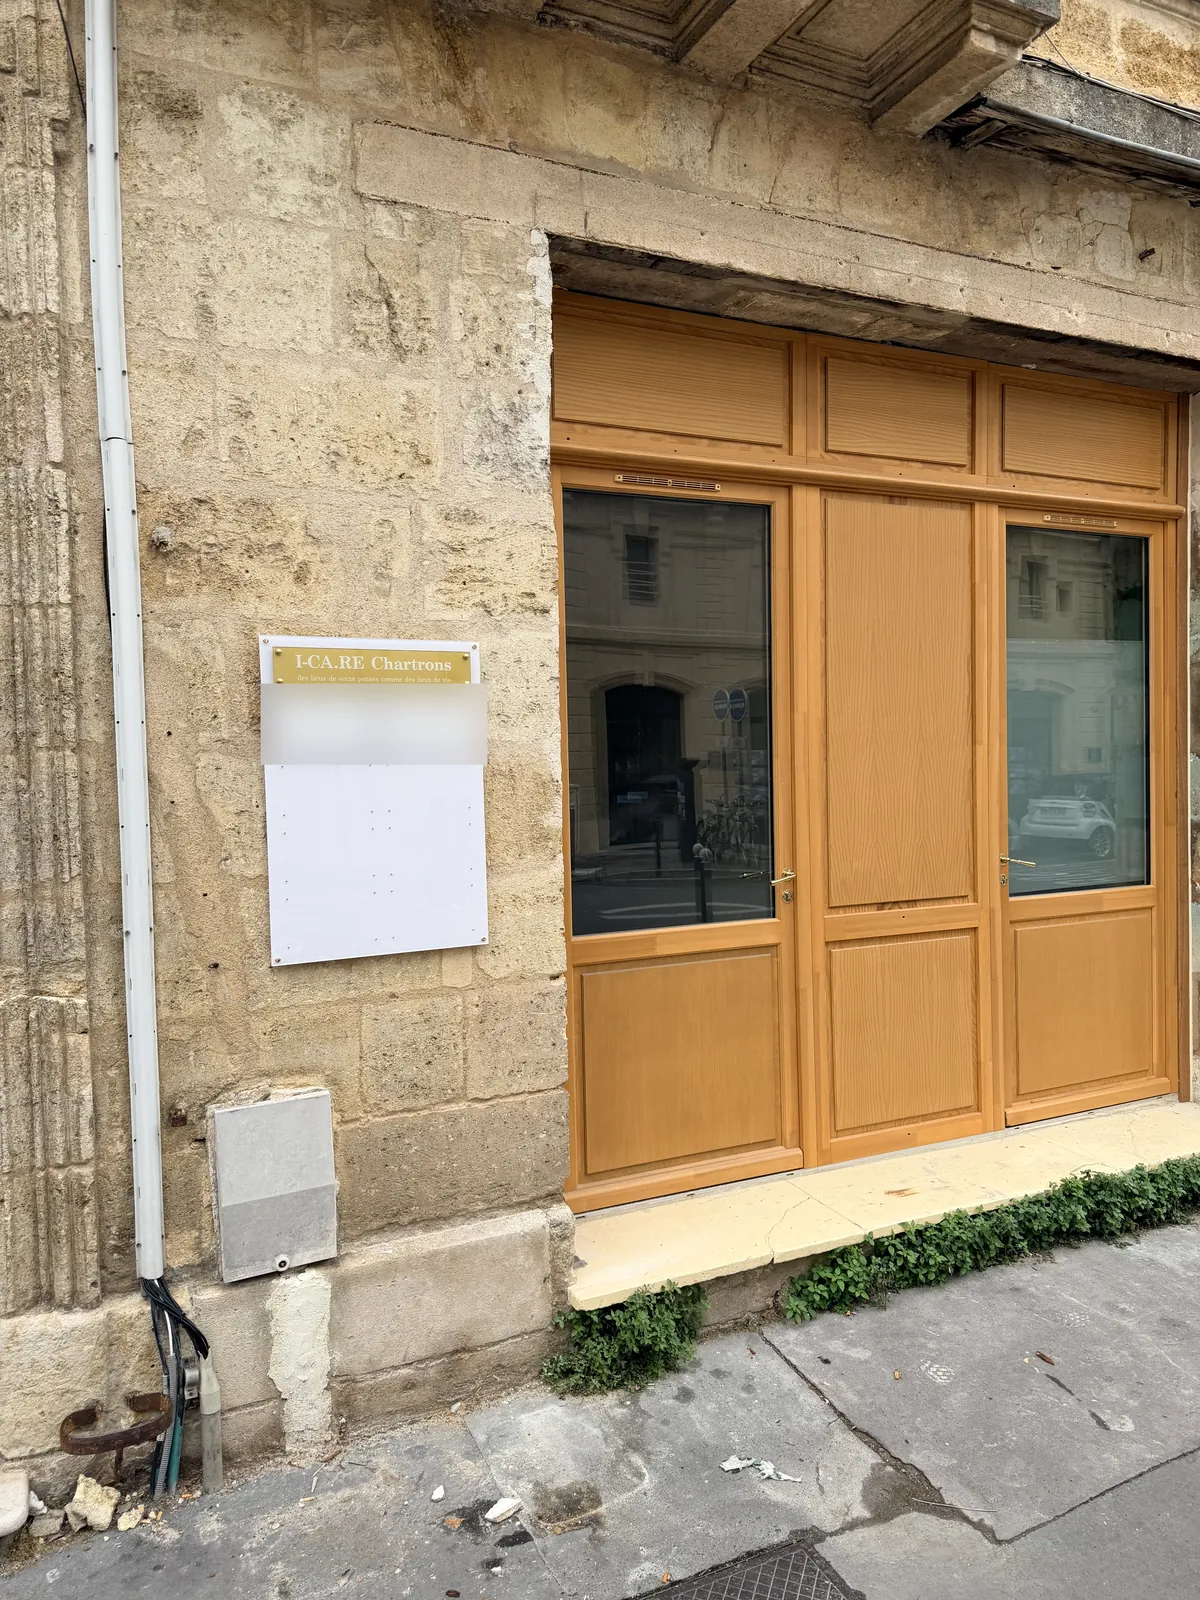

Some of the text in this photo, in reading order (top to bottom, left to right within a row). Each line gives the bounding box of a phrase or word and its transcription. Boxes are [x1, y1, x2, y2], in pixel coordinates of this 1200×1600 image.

[295, 654, 452, 671] I-CA.RE Chartrons
[297, 674, 309, 682] des
